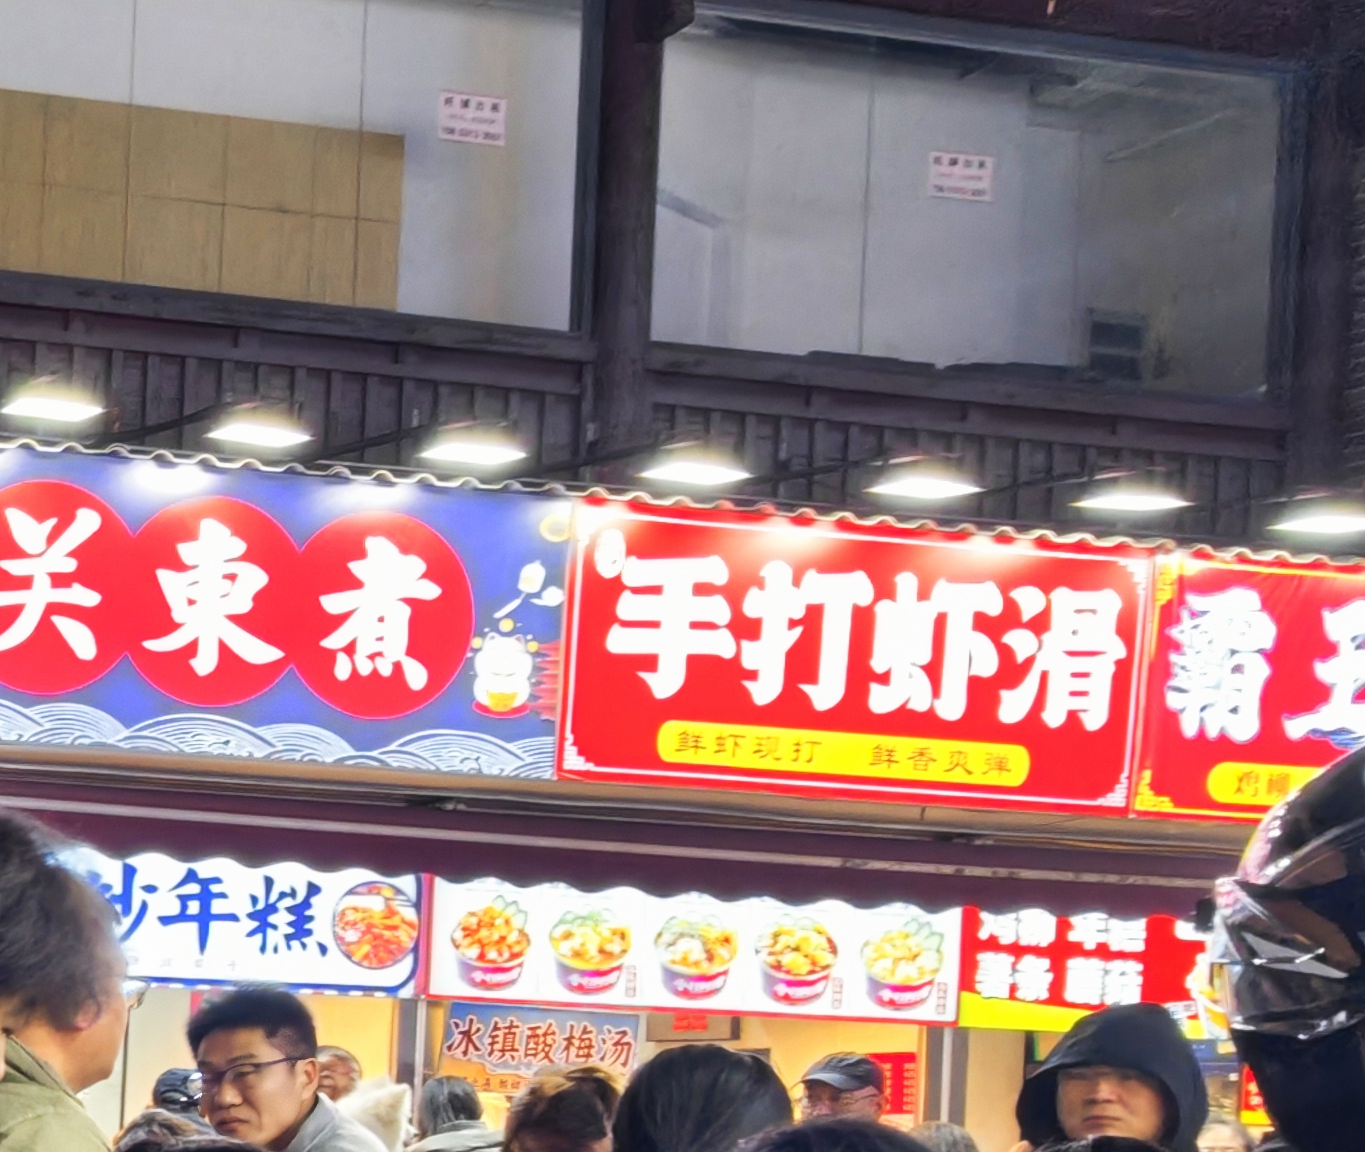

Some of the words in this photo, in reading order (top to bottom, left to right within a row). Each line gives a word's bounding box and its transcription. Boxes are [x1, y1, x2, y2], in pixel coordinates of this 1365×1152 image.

[606, 555, 1128, 732] 手打虾滑
[673, 729, 823, 766] 鲜虾现打
[868, 743, 1014, 780] 鲜香爽弹
[444, 1013, 636, 1070] 冰镇酸梅汤
